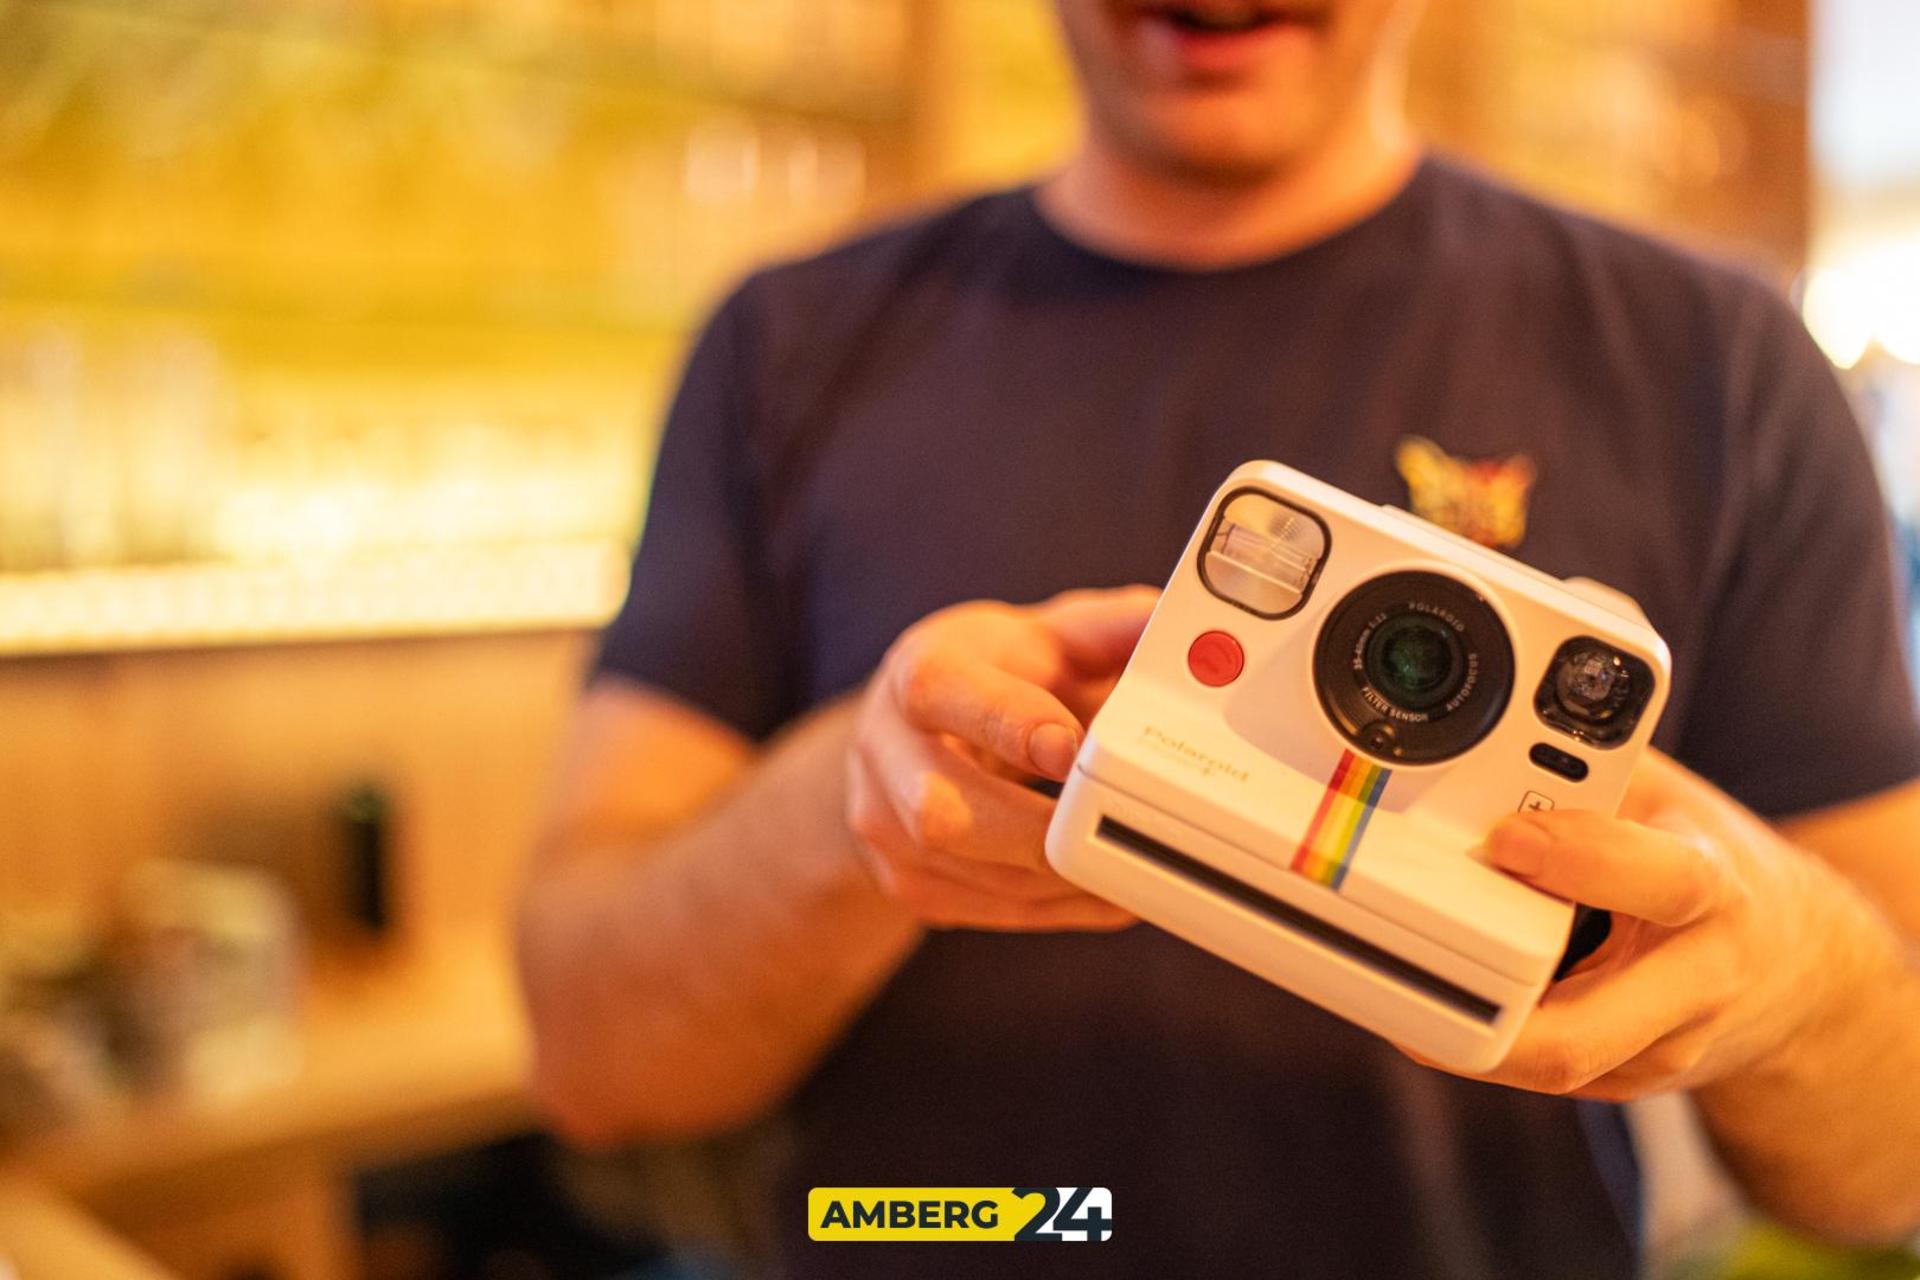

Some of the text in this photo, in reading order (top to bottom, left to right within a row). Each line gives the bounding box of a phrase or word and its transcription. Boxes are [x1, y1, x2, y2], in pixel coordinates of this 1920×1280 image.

[1408, 602, 1465, 632] POLAROID
[1361, 686, 1429, 722] FILTER SENSOR
[1446, 652, 1479, 711] AUTOFOCUS
[1143, 724, 1249, 783] Polaroid
